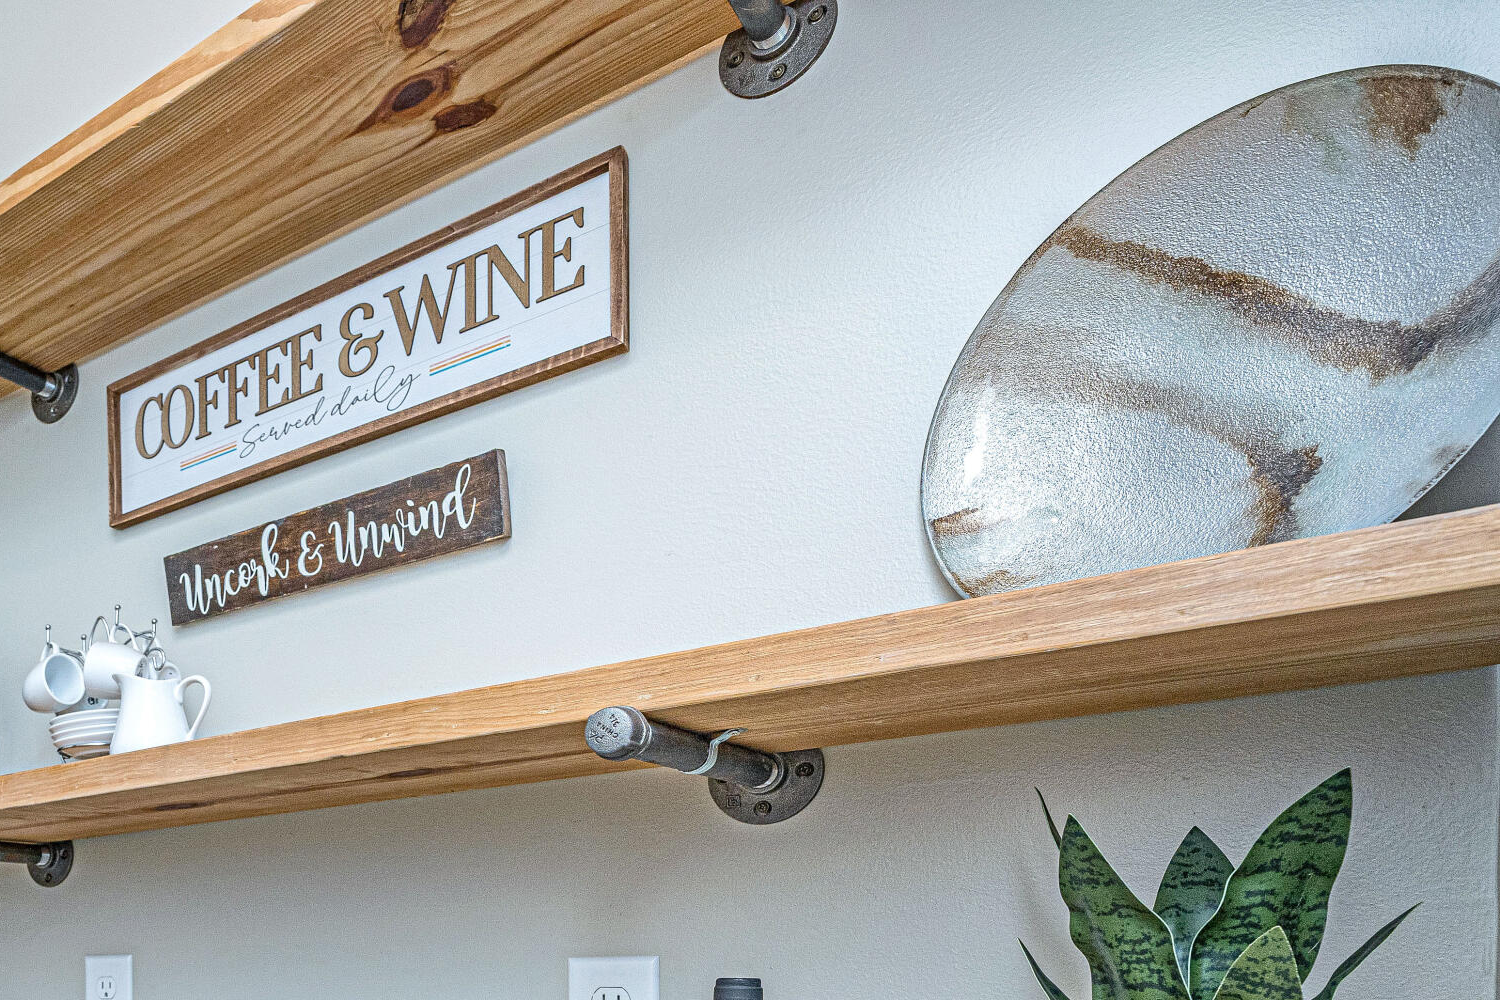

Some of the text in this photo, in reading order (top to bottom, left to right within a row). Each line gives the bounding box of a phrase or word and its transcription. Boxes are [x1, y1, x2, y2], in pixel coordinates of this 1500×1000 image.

[134, 206, 587, 461] COFFEE & WINE
[240, 365, 422, 459] Served daily
[179, 465, 478, 616] Uncork & Unwind
[596, 721, 619, 738] CHINA
